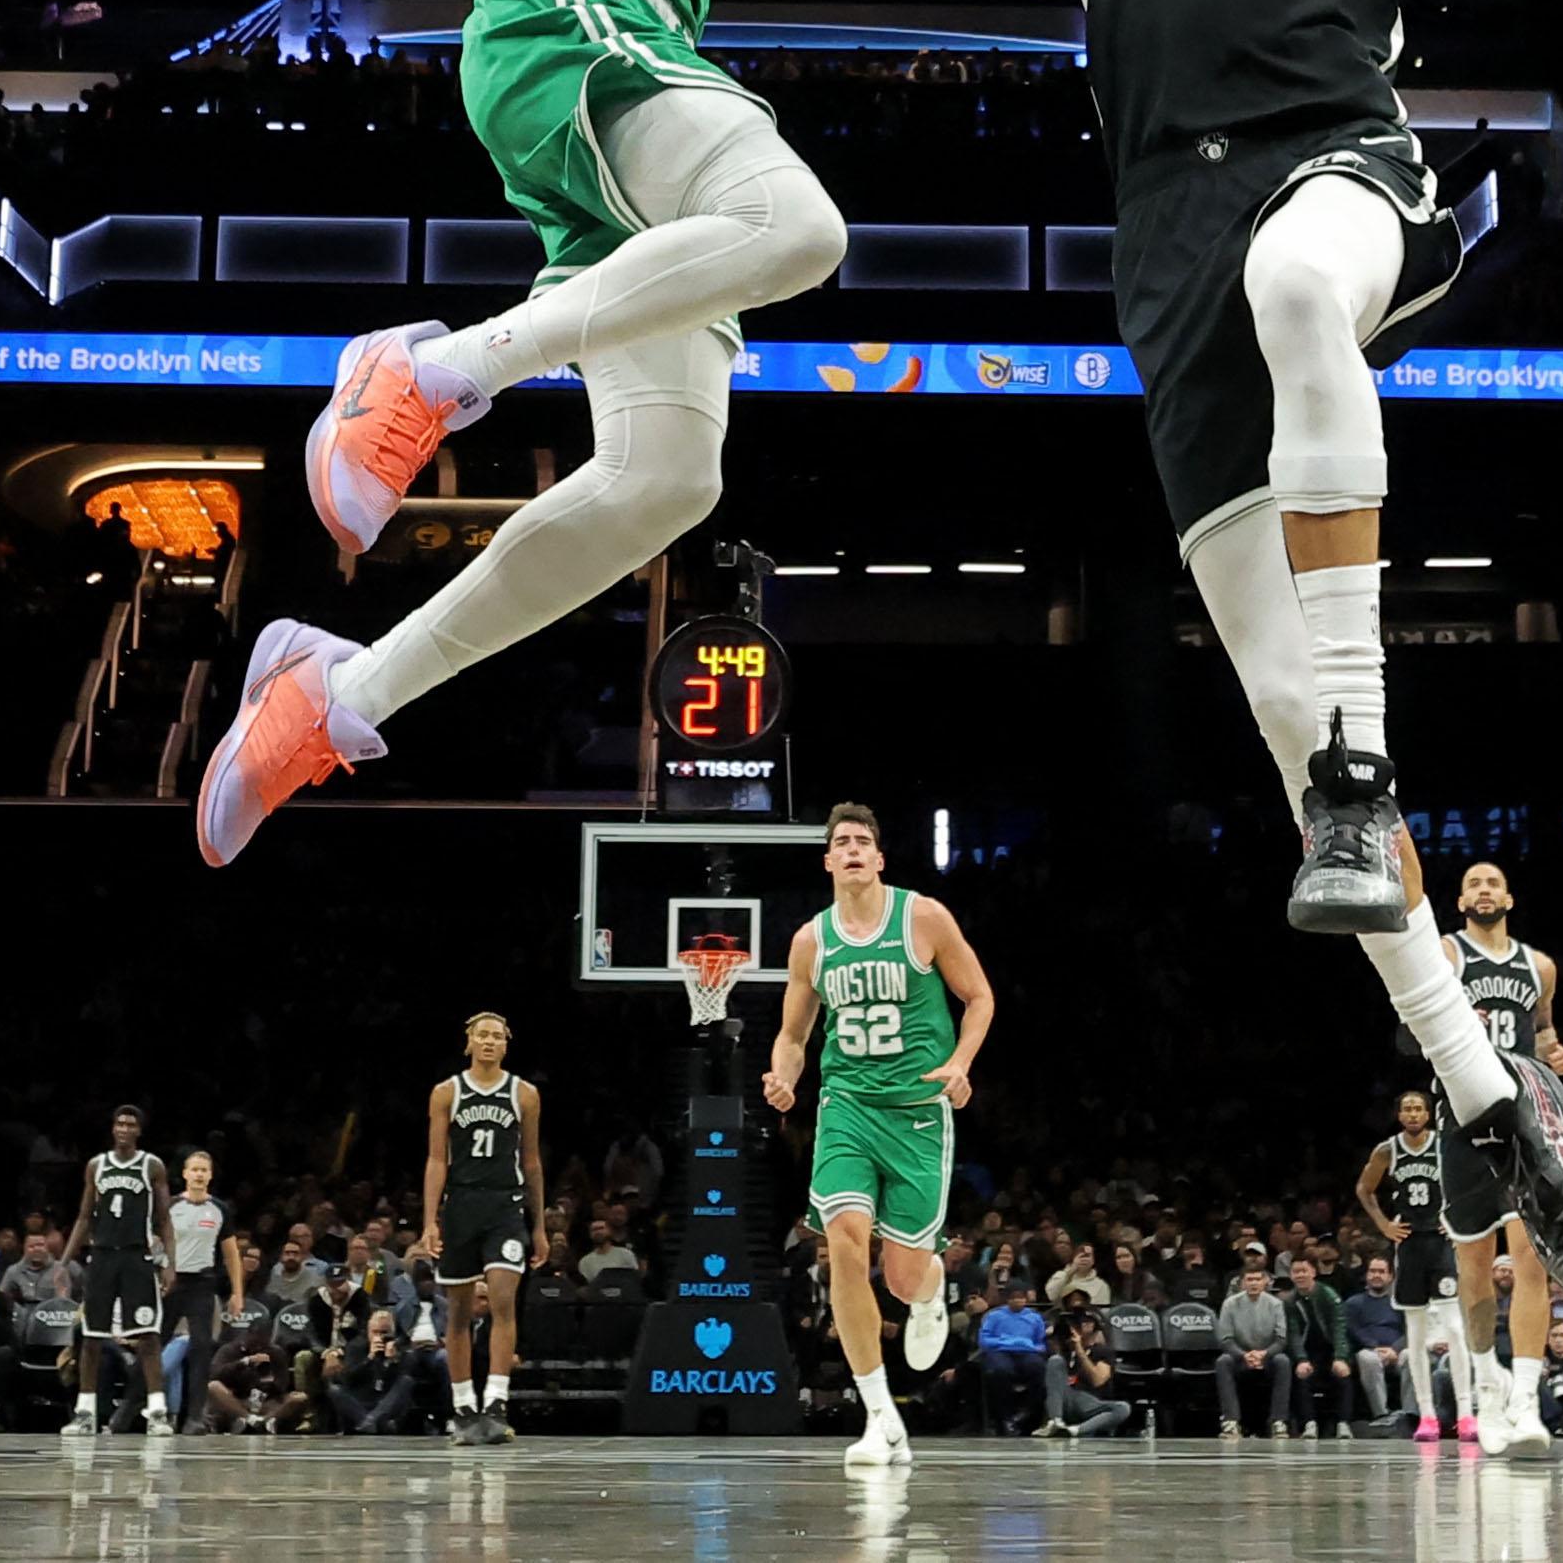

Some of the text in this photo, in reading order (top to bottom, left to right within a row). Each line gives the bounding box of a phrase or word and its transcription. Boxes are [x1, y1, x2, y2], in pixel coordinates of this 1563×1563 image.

[16, 348, 60, 371] the
[70, 349, 191, 374] Brooklyn
[201, 350, 262, 373] Nets
[1012, 364, 1047, 383] WISE
[1394, 364, 1437, 386] the
[698, 645, 766, 677] 4:49
[681, 678, 761, 735] 21
[824, 960, 907, 1010] BOSTON
[1463, 975, 1538, 1012] BROOKLYN
[836, 1003, 904, 1057] 52
[1488, 1009, 1517, 1050] 13
[454, 1104, 515, 1129] BROOKLYN
[471, 1128, 495, 1158] 21
[695, 1148, 738, 1158] BARCLAYS
[109, 1193, 123, 1218] 4
[1408, 1182, 1430, 1206] 33
[678, 1282, 750, 1297] BARCLAYS
[1110, 1315, 1152, 1328] QATAR
[1169, 1315, 1212, 1327] QATAR
[649, 1369, 776, 1395] BARCLAYS
